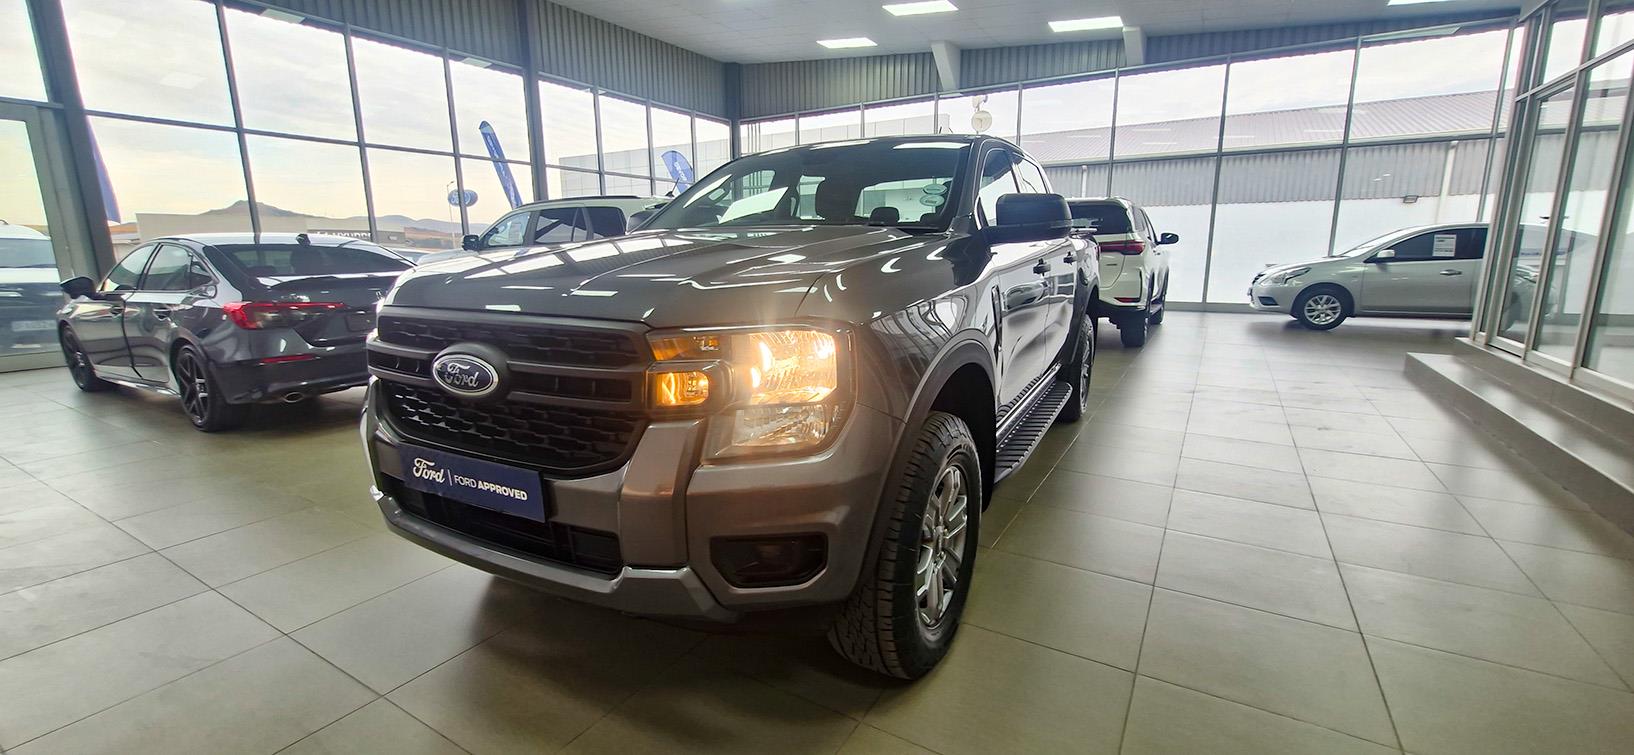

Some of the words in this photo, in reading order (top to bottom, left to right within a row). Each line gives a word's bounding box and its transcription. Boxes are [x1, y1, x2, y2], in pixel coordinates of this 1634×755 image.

[444, 362, 479, 387] Ford
[412, 457, 445, 483] Ford
[453, 475, 477, 488] FORD
[478, 480, 528, 501] APPROVED
